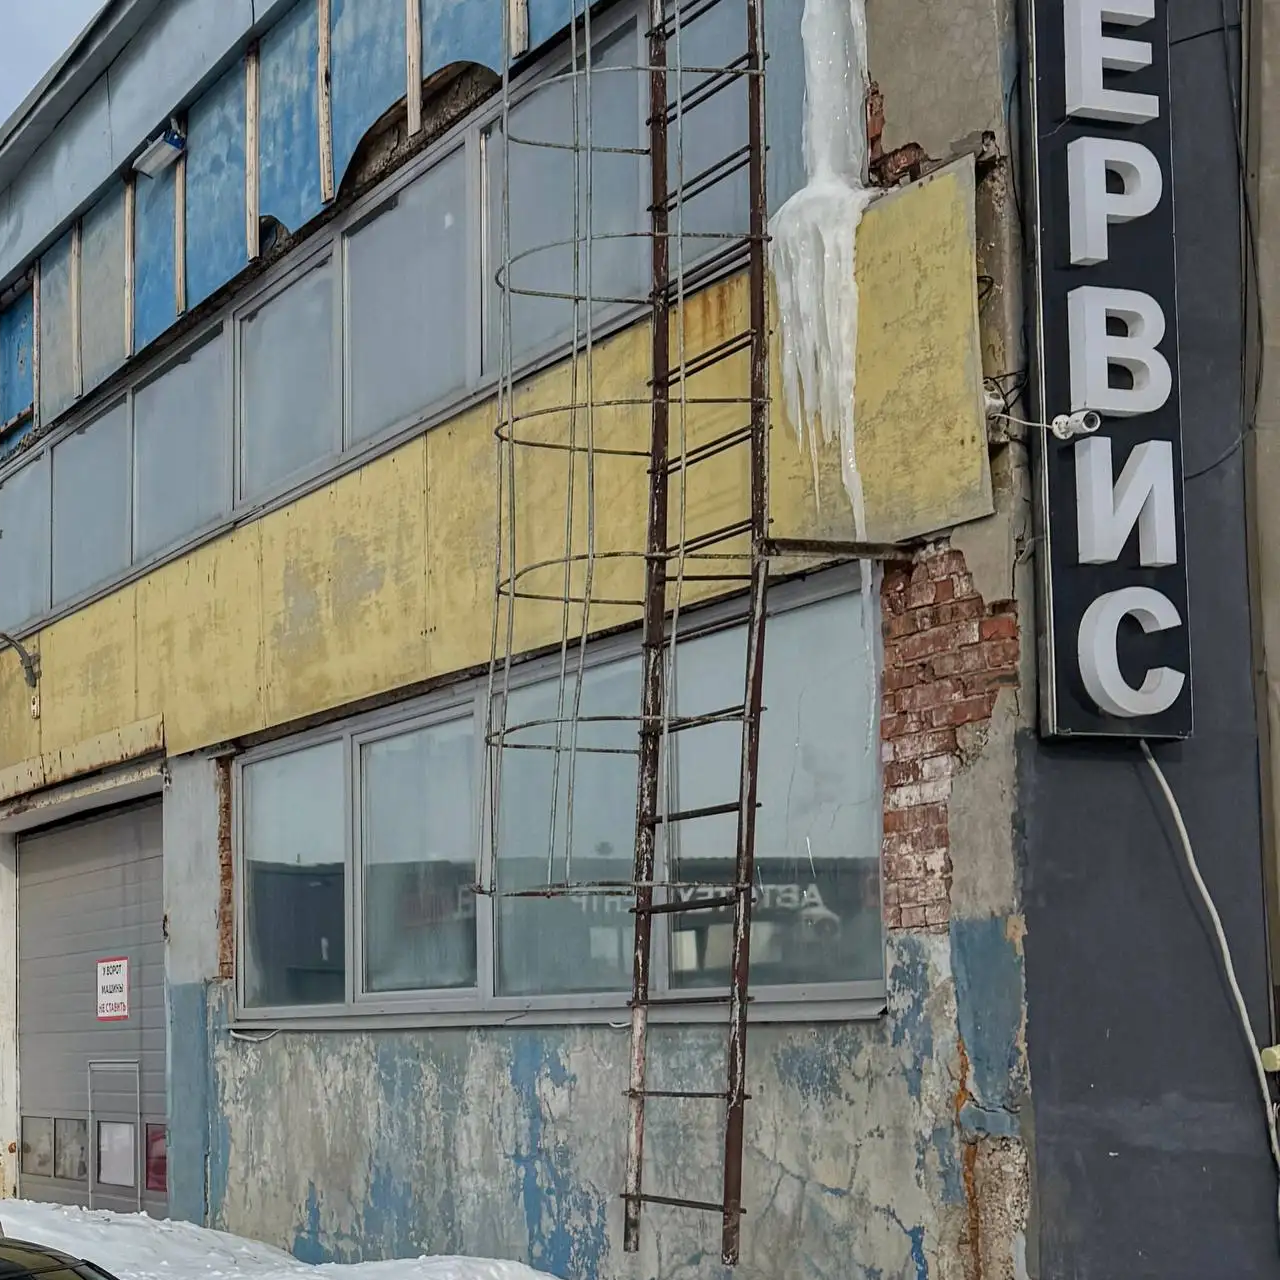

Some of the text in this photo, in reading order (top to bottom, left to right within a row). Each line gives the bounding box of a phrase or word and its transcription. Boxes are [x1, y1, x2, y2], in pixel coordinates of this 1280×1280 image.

[1063, 0, 1186, 718] ЕРВИС
[107, 964, 122, 975] ВОРОТ
[102, 983, 123, 994] МАШИНЫ
[106, 1002, 126, 1013] СТАВИТЬ
